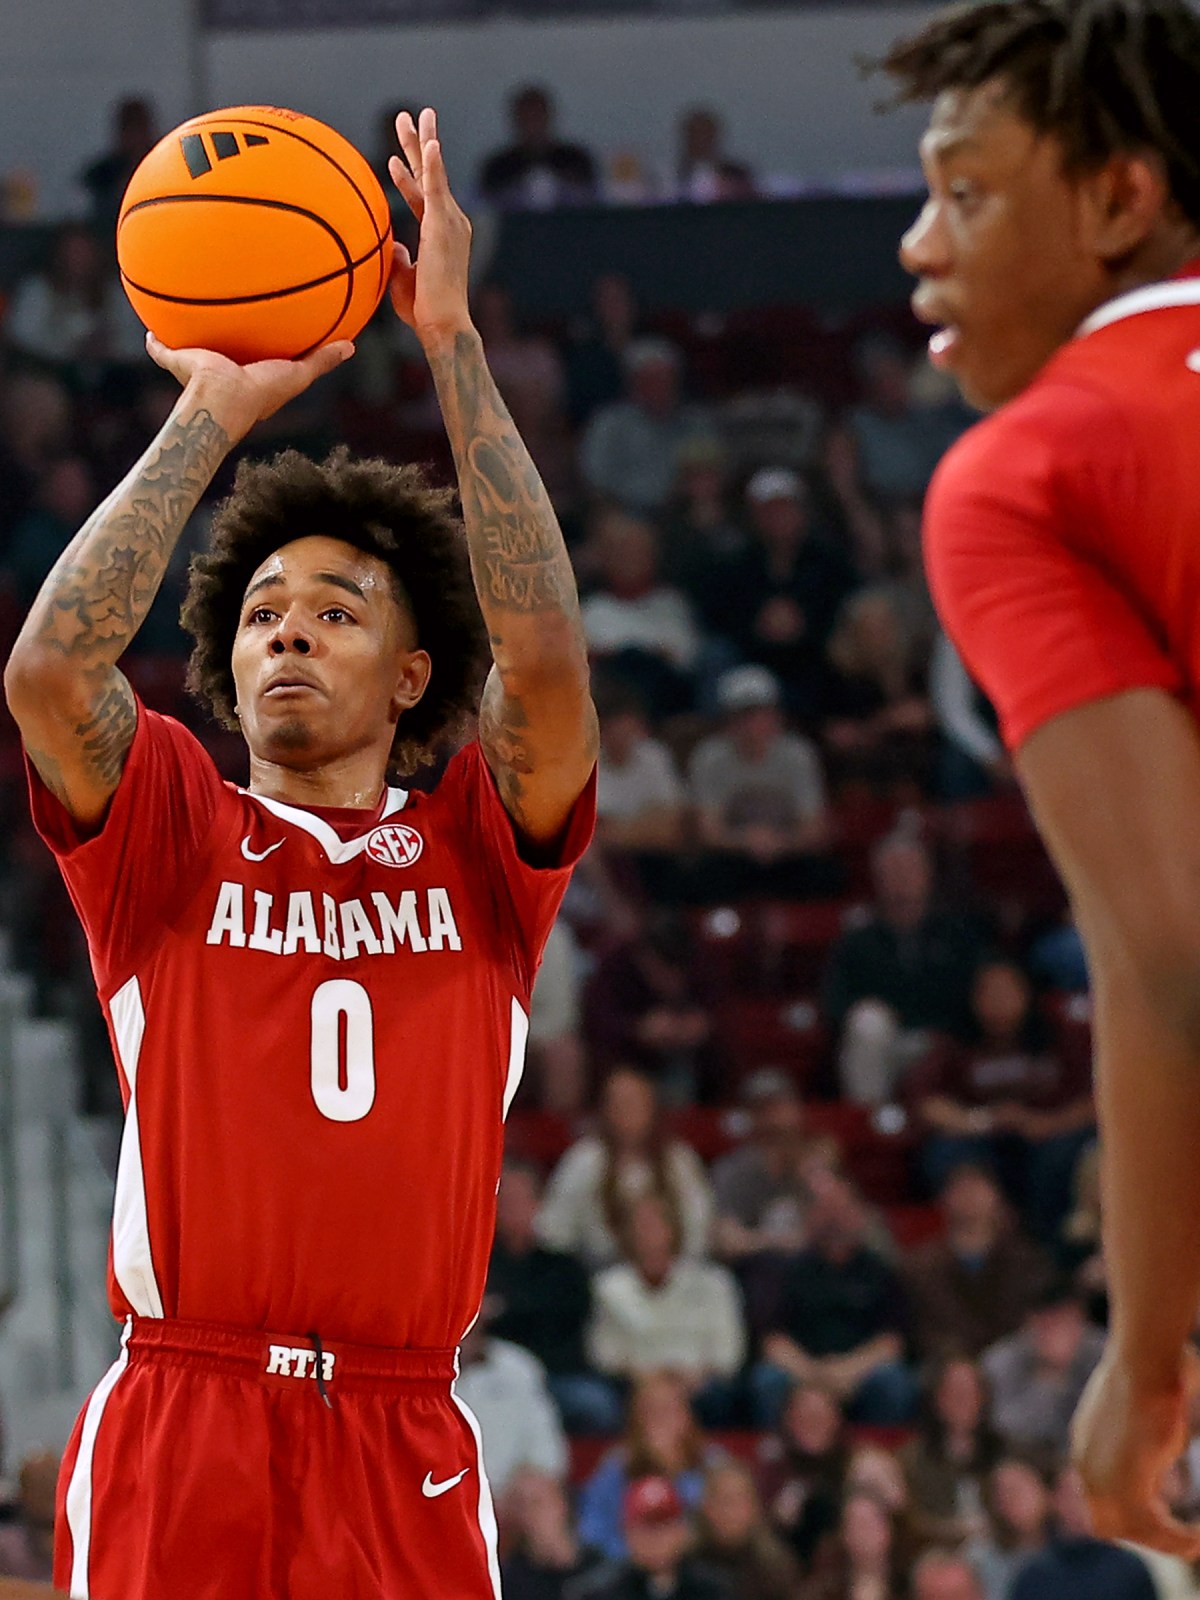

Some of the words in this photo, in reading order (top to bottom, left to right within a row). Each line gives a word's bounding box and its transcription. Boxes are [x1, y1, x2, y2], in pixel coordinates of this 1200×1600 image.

[368, 826, 420, 865] SEC
[206, 881, 462, 960] ALABAMA
[311, 978, 375, 1122] 0
[265, 1344, 336, 1381] RTR
